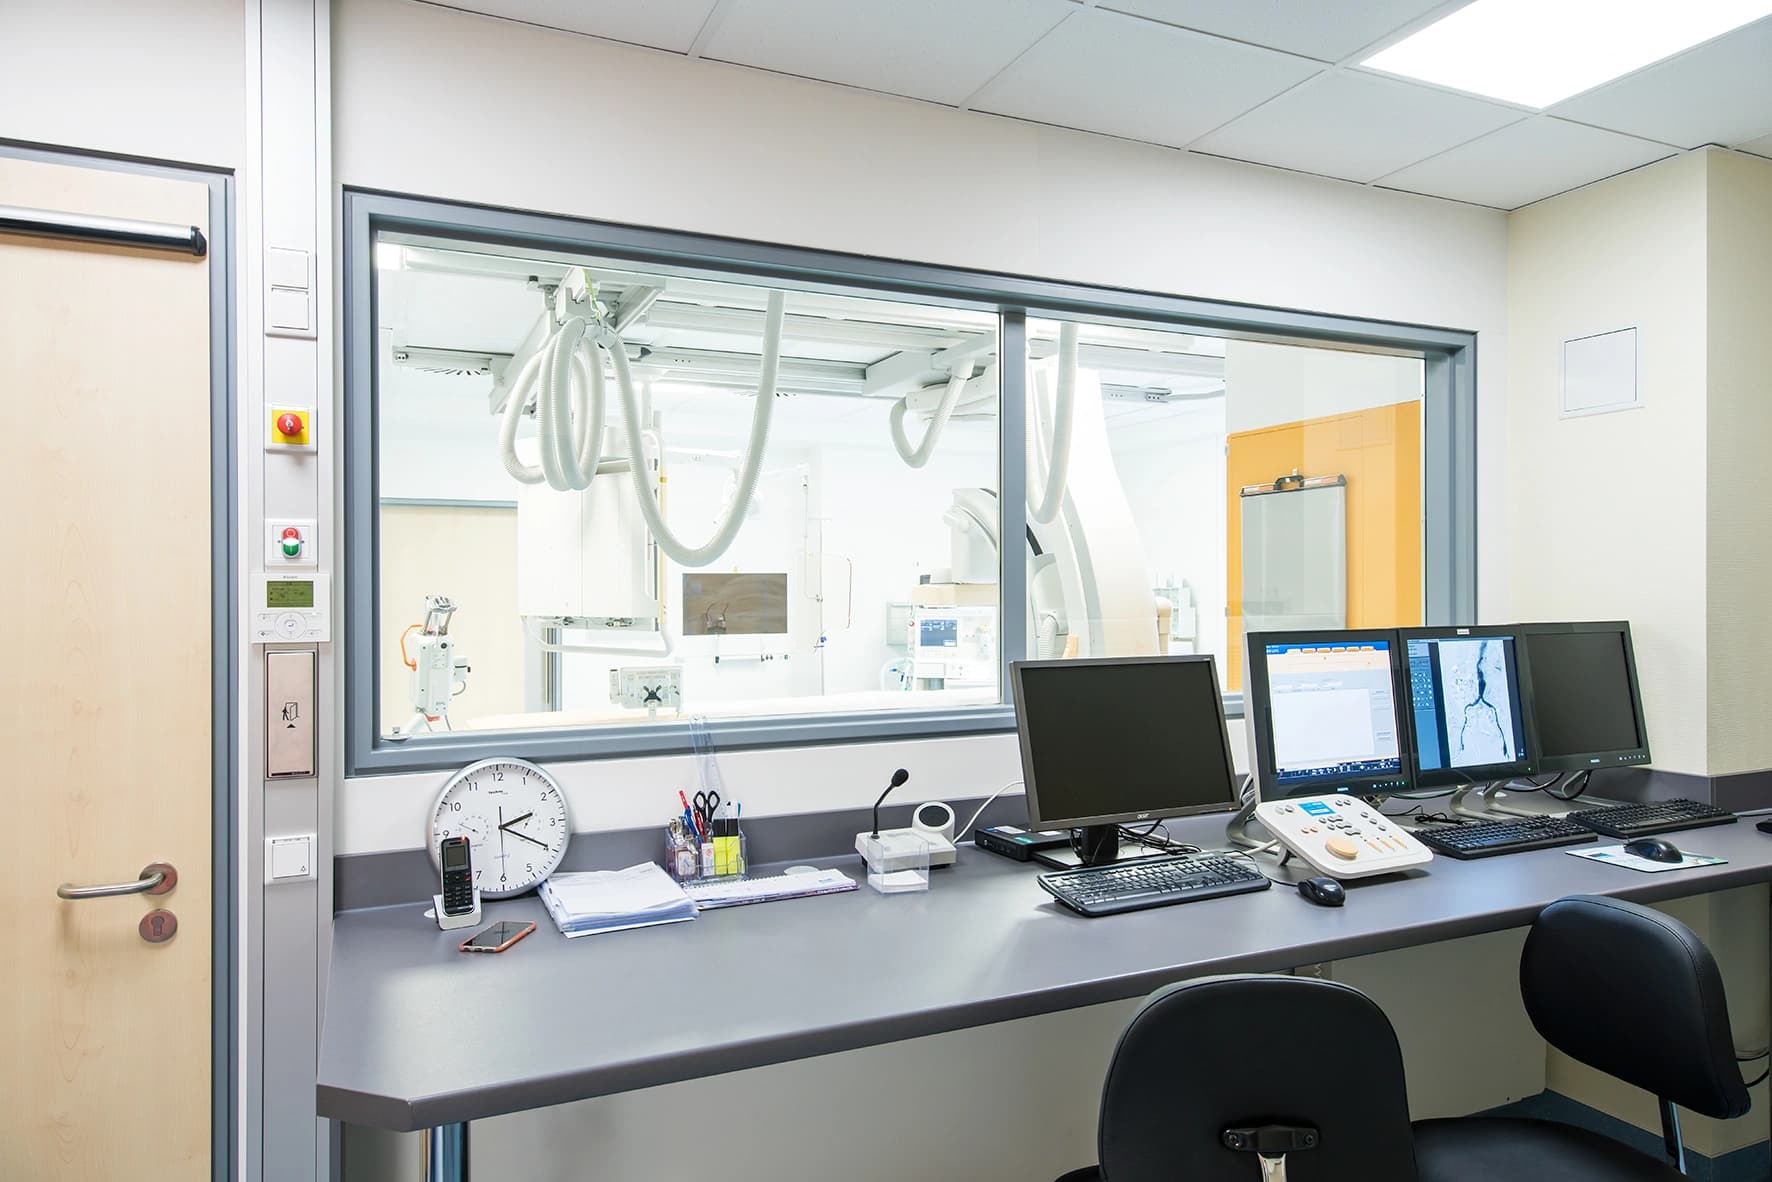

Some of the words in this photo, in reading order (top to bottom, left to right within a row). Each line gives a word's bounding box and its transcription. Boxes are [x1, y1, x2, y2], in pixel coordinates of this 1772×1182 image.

[491, 772, 503, 781] 12
[468, 783, 478, 791] 11
[540, 792, 547, 801] 2
[449, 802, 461, 811] 10
[549, 818, 556, 826] 3
[443, 830, 449, 838] 9
[526, 863, 532, 872] 5
[475, 870, 482, 879] 7
[500, 873, 506, 882] 6
